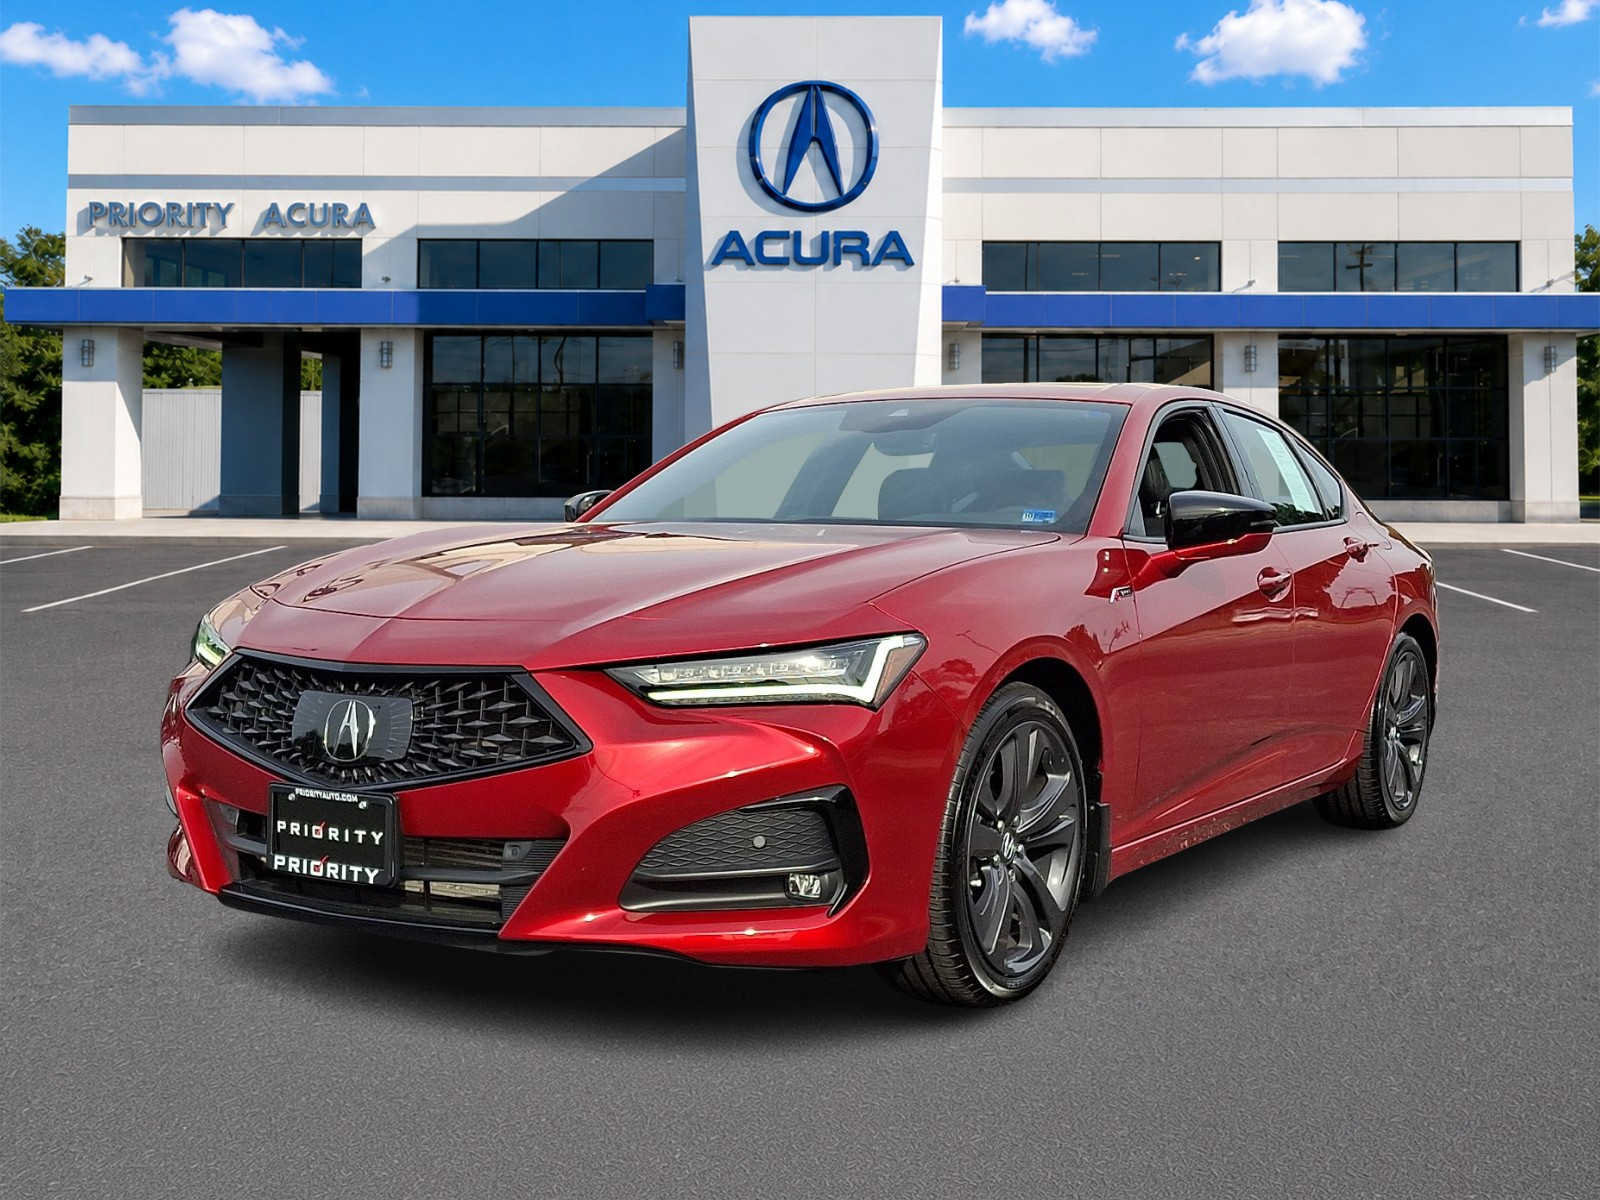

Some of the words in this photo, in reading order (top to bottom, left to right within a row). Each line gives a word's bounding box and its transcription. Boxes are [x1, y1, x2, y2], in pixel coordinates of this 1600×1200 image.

[88, 201, 235, 228] PRIORITY
[263, 202, 376, 229] ACURA
[711, 230, 915, 266] ACURA
[295, 788, 358, 802] PRIORITYAUTO.COM
[277, 820, 383, 845] PRIORITY
[273, 854, 379, 884] PRIORITY
